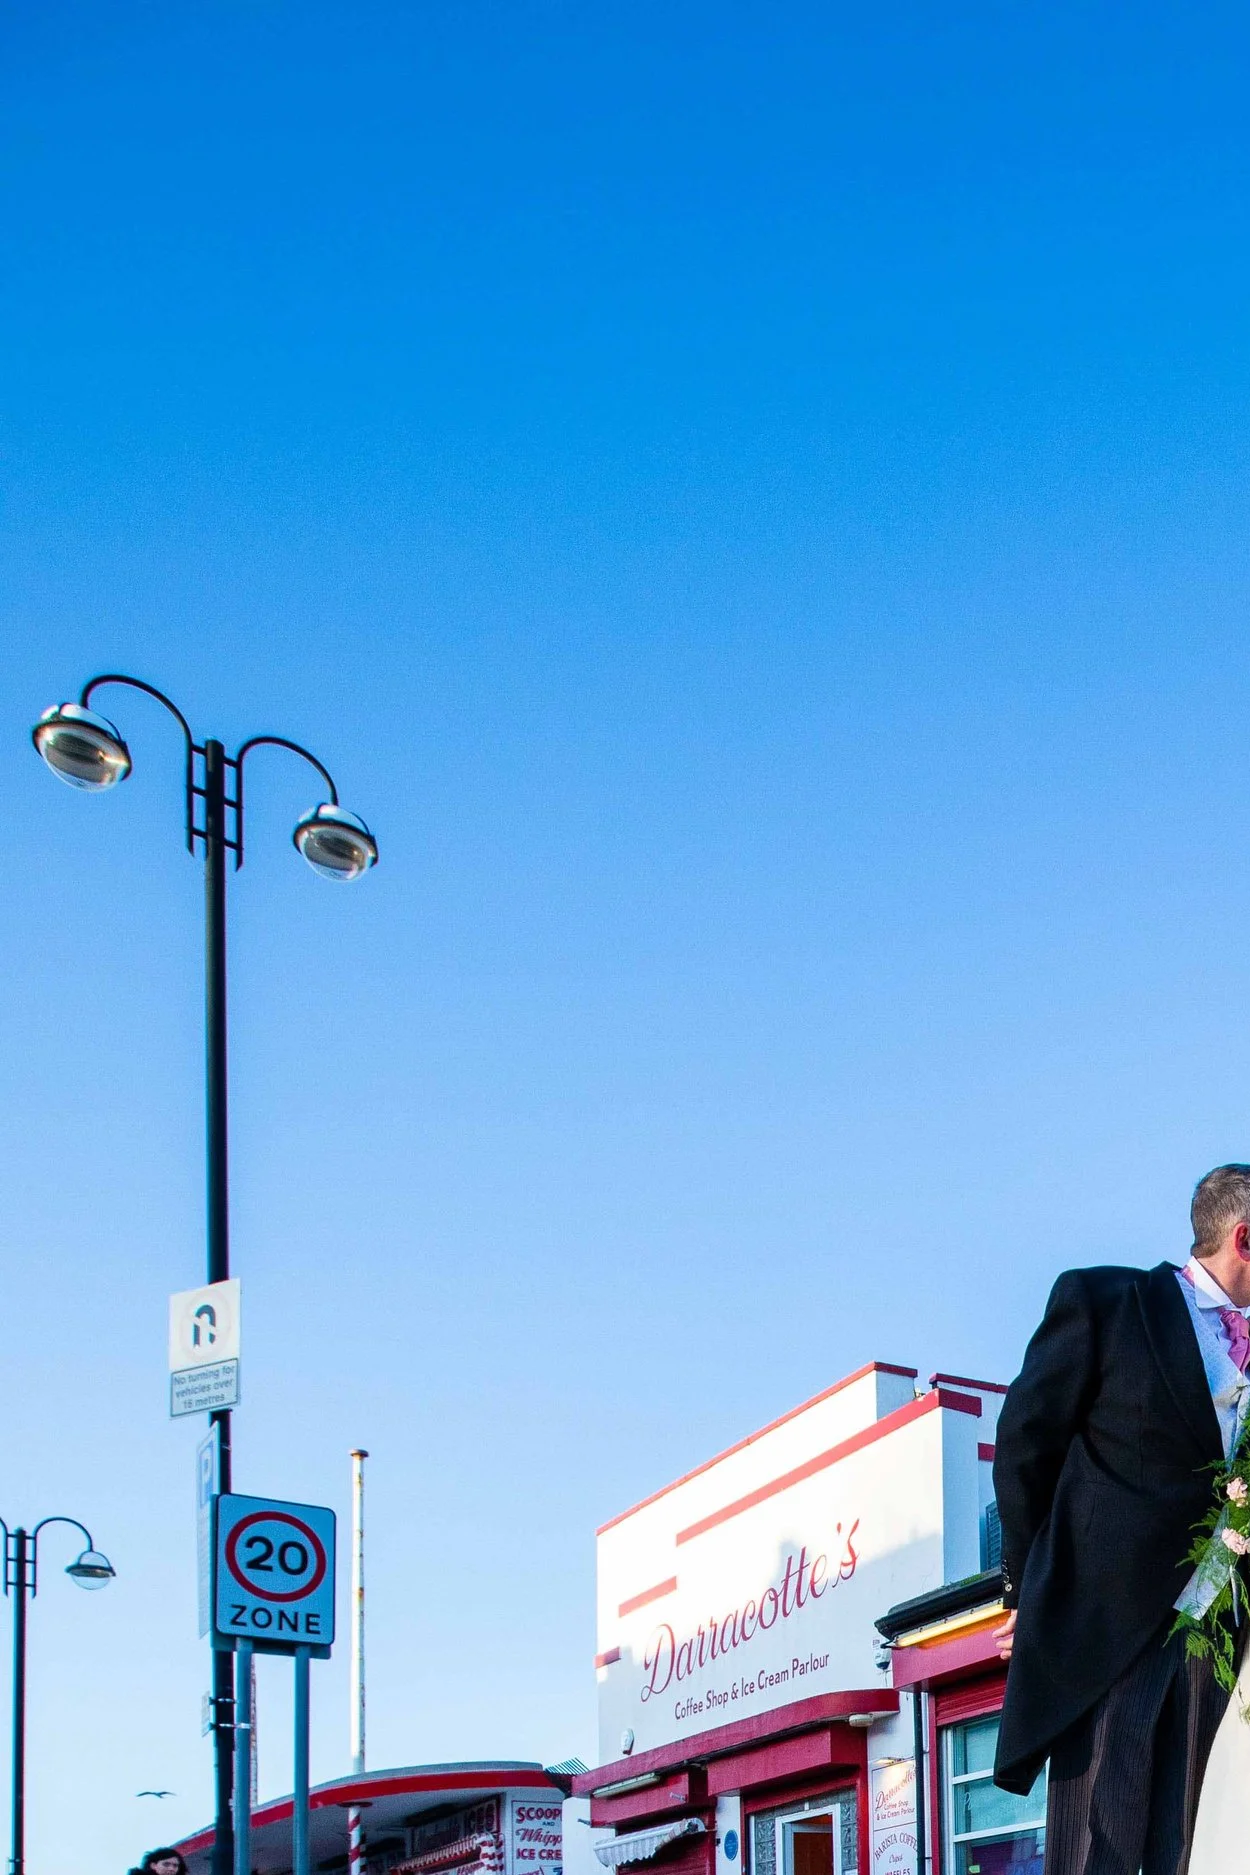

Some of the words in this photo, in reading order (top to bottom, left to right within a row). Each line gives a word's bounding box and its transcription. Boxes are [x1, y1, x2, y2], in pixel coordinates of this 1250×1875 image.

[174, 1376, 186, 1385] No
[188, 1369, 220, 1383] turning
[222, 1365, 236, 1375] for
[176, 1384, 211, 1398] vehicles
[213, 1379, 234, 1390] over
[195, 1393, 225, 1406] metres
[245, 1536, 309, 1576] 20
[229, 1603, 321, 1634] ZONE
[640, 1518, 860, 1702] Darracotte's
[674, 1698, 703, 1720] Coffee
[706, 1690, 729, 1709] Shop
[731, 1682, 739, 1700] &
[741, 1677, 755, 1697] Ice
[758, 1668, 789, 1690] Cream
[792, 1652, 830, 1678] Parlour
[516, 1806, 562, 1825] SCOOP
[516, 1827, 562, 1846] Whipp
[516, 1848, 536, 1861] ICE
[538, 1848, 562, 1861] CRE
[875, 1833, 898, 1861] BARISTA
